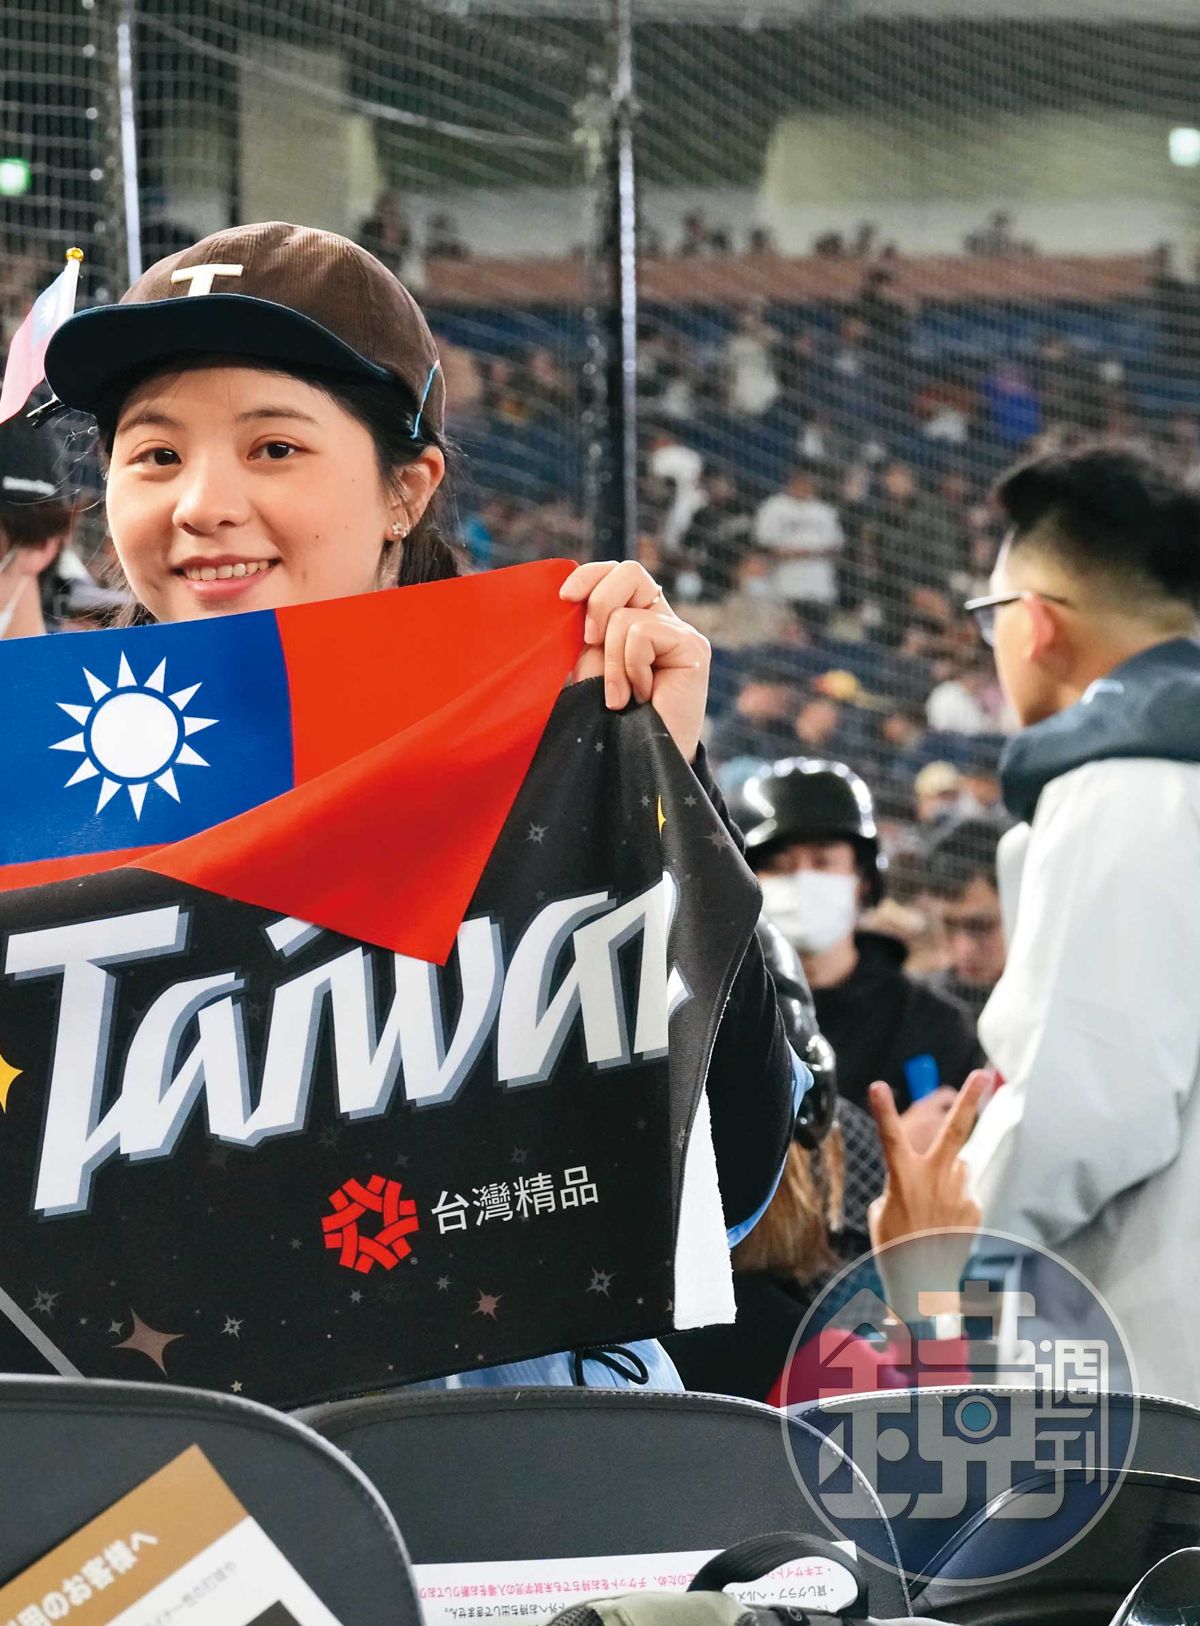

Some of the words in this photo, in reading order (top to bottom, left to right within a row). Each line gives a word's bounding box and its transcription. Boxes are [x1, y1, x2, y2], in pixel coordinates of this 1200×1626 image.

[170, 263, 244, 297] T
[431, 1165, 599, 1235] 台灣精品
[3, 1531, 159, 1626] 用のお客様へ
